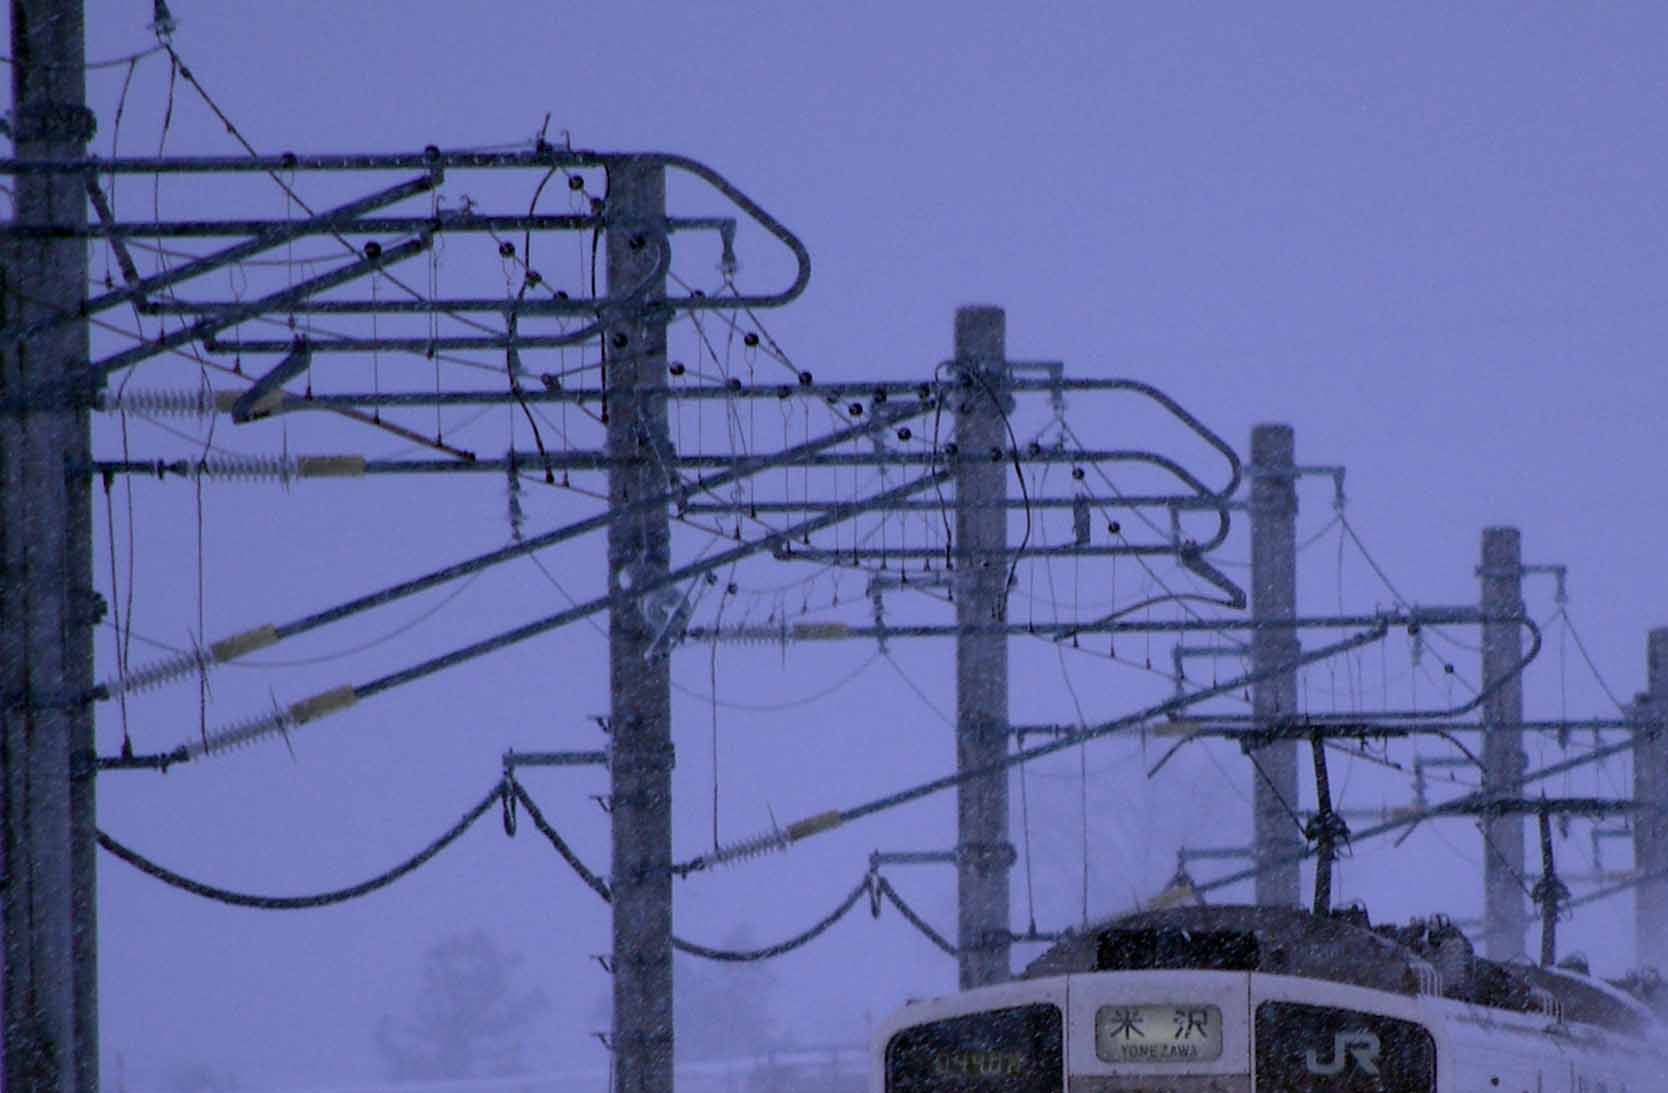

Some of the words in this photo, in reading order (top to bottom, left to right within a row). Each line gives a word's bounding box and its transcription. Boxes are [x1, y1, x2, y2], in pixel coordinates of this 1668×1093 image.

[1110, 1008, 1208, 1040] 米沢
[1121, 1044, 1198, 1058] YONEZAWA
[1305, 1032, 1380, 1075] JR
